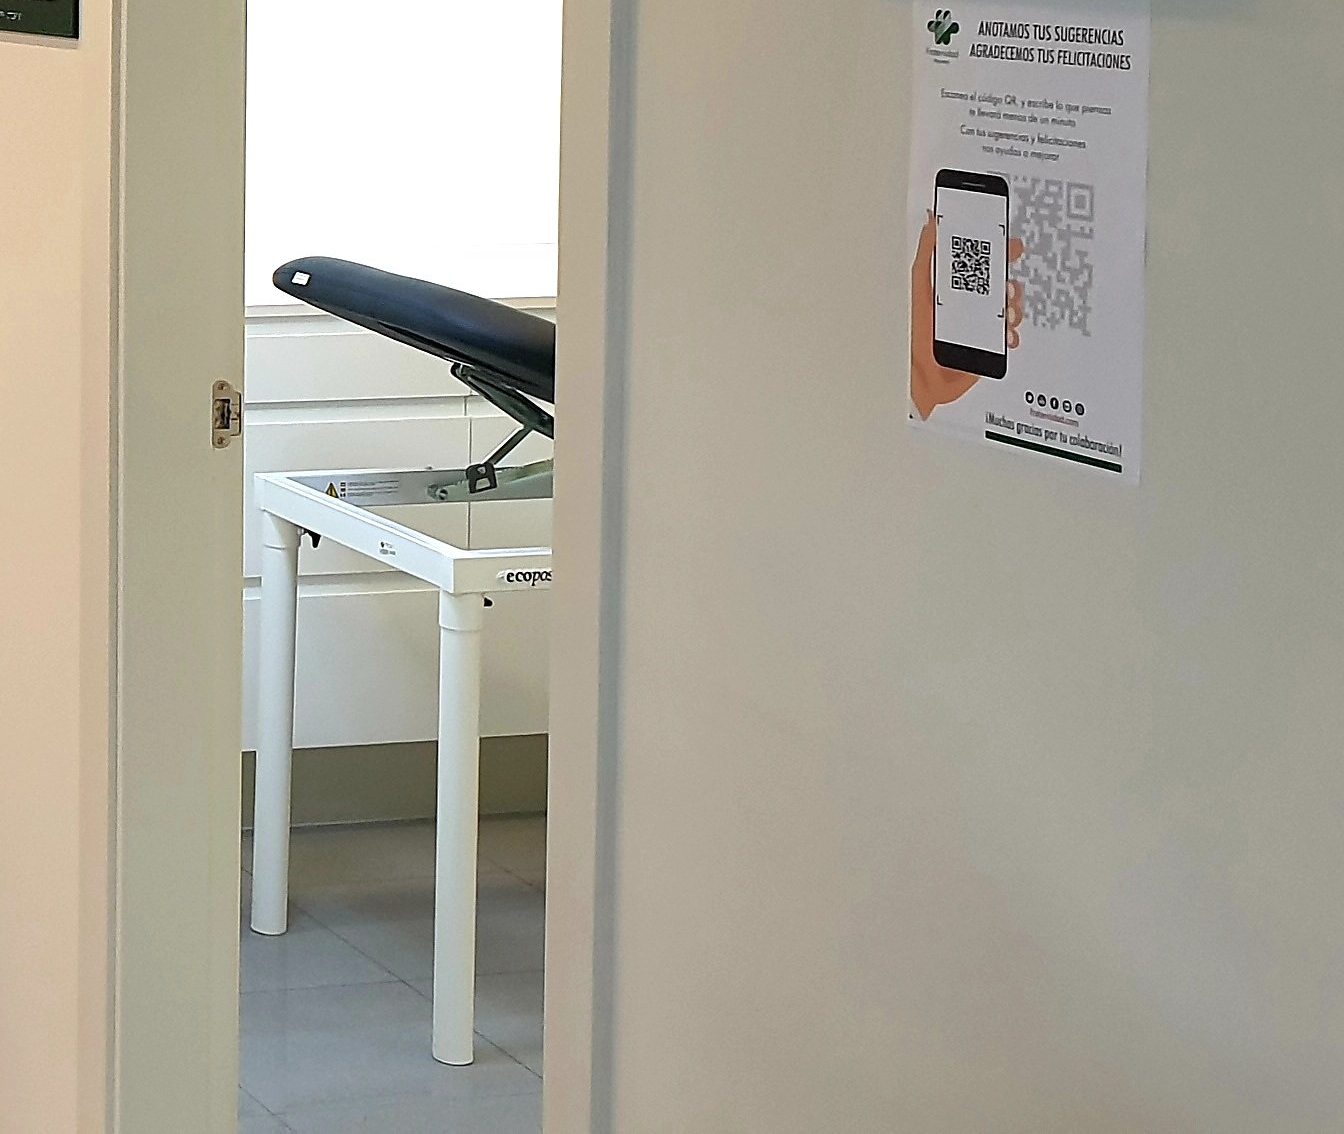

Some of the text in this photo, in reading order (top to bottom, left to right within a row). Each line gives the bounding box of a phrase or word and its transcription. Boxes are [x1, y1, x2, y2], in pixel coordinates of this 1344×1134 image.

[977, 20, 1125, 47] ANOTAMOS TUS SUGERENCIAS
[968, 43, 1035, 64] AGRADECEMOS
[1037, 47, 1055, 64] TUS
[1057, 49, 1131, 71] FELICITACIONES
[1016, 422, 1043, 437] gracias
[1044, 429, 1058, 441] por
[1059, 432, 1068, 444] tu
